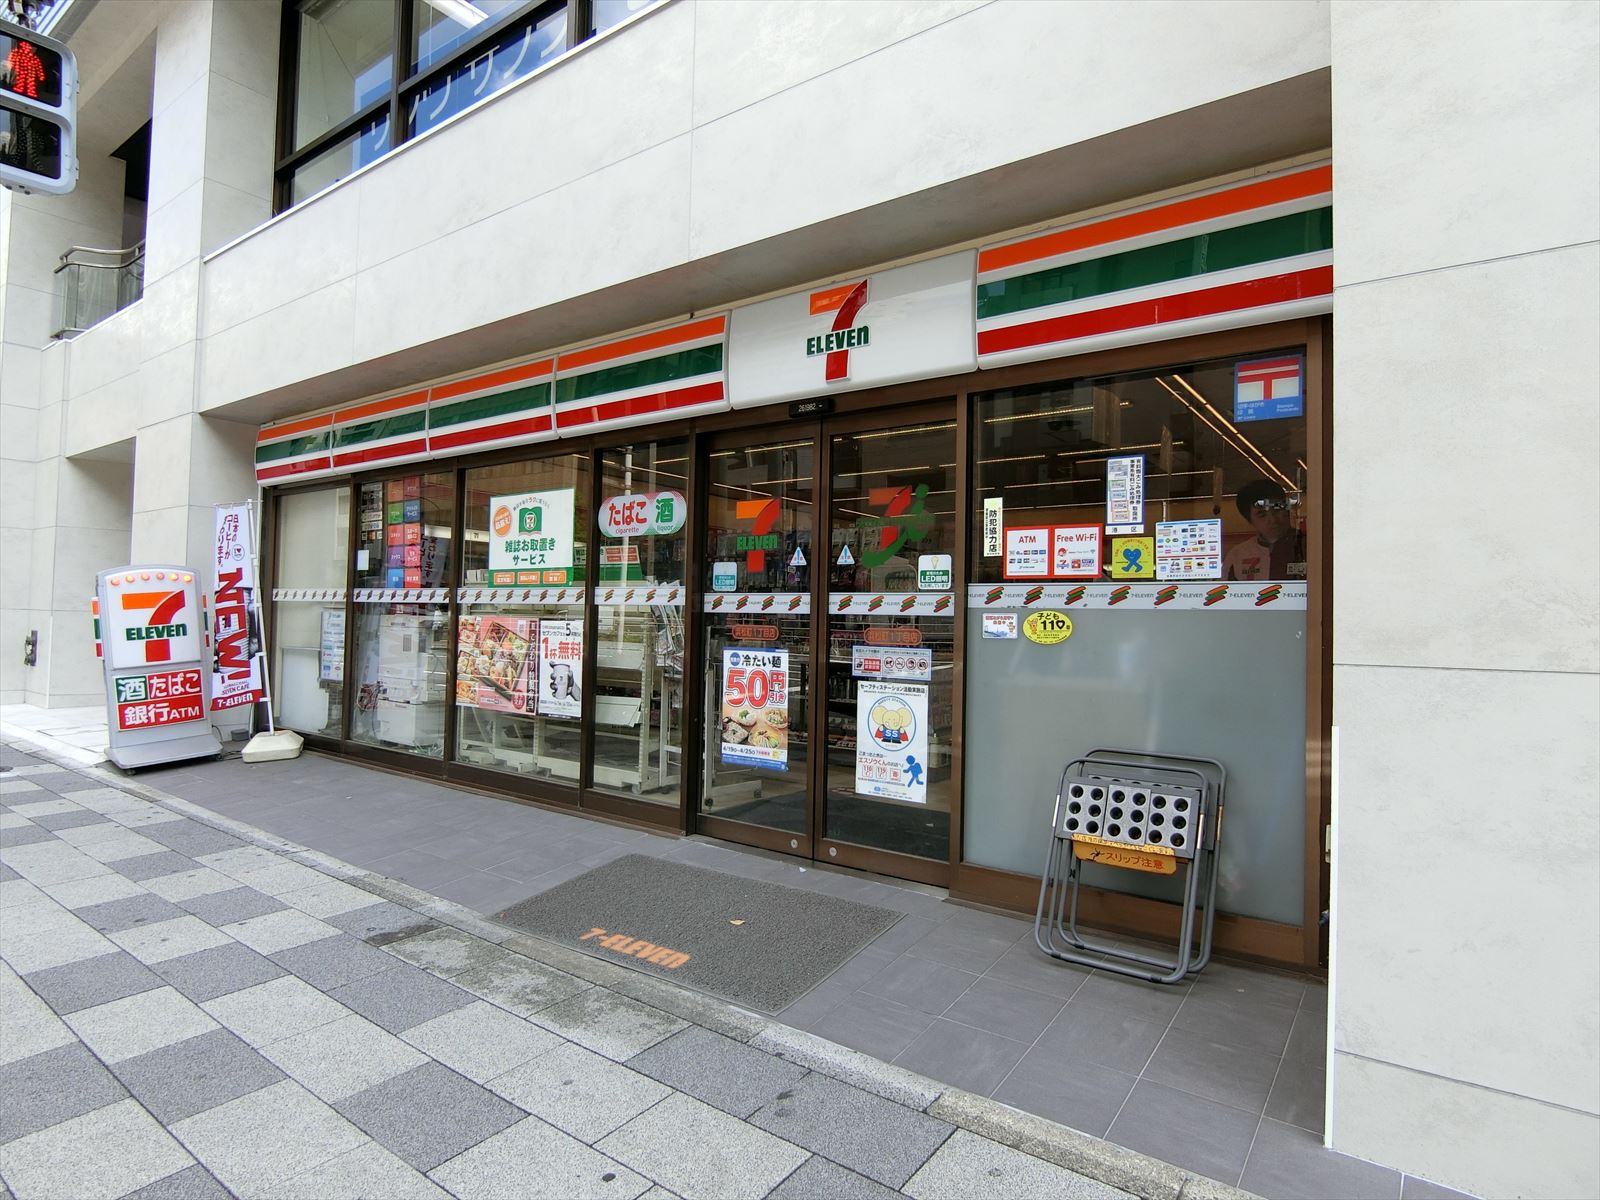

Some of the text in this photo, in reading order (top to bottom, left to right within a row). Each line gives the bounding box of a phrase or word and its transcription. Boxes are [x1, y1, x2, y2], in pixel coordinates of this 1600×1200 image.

[810, 279, 868, 381] 7
[609, 497, 674, 527] たばこ 酒
[616, 524, 674, 535] cigarette liquor
[736, 498, 780, 573] 7
[988, 510, 998, 552] 防犯協力店
[1056, 533, 1097, 543] Free Wi-Fi
[505, 538, 556, 553] 雑誌お取置き
[1018, 535, 1037, 544] ATM
[512, 554, 546, 566] サービス
[121, 589, 186, 662] 7
[215, 567, 251, 684] NEW!
[1037, 612, 1060, 621] 子ども
[741, 654, 782, 669] 冷たい麺
[117, 672, 201, 703] 酒 たばこ
[124, 702, 200, 725] 銀行ATM
[886, 729, 899, 738] SS
[1106, 852, 1165, 870] スリップ注意
